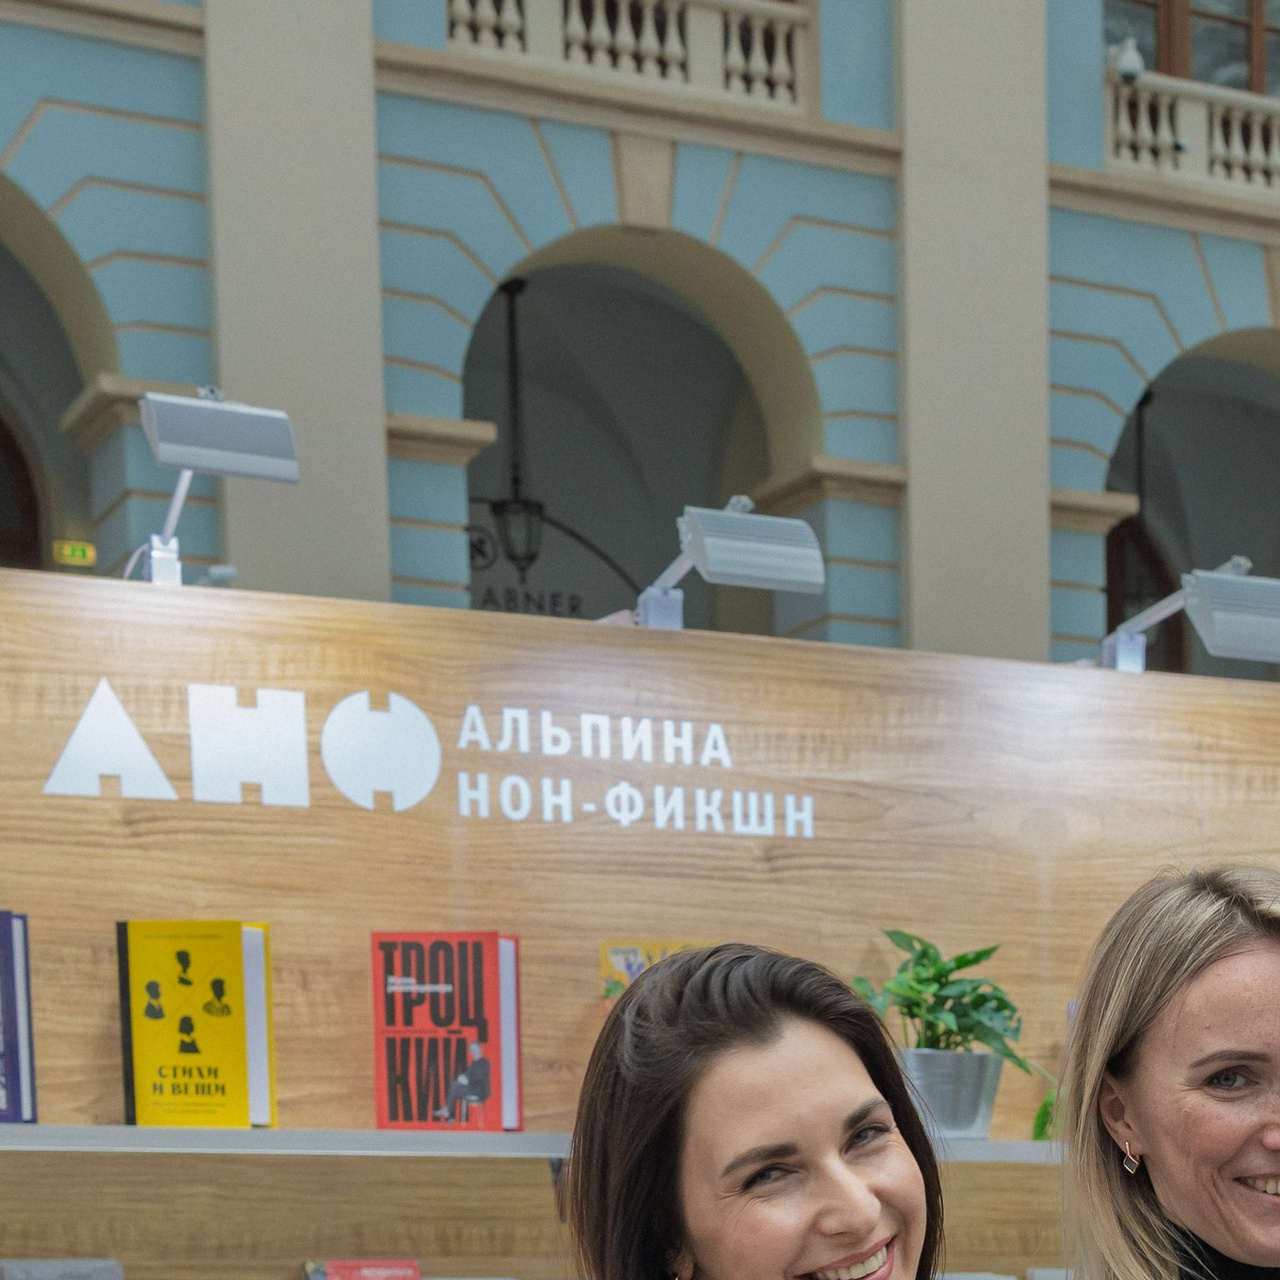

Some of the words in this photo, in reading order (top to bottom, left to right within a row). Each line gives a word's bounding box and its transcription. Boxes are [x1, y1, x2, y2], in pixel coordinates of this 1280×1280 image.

[457, 704, 734, 768] АЛЬПИНА
[457, 772, 816, 839] НОН-ФИКШН
[378, 940, 488, 1043] ТРОЦ
[157, 1064, 219, 1079] СТИХИ
